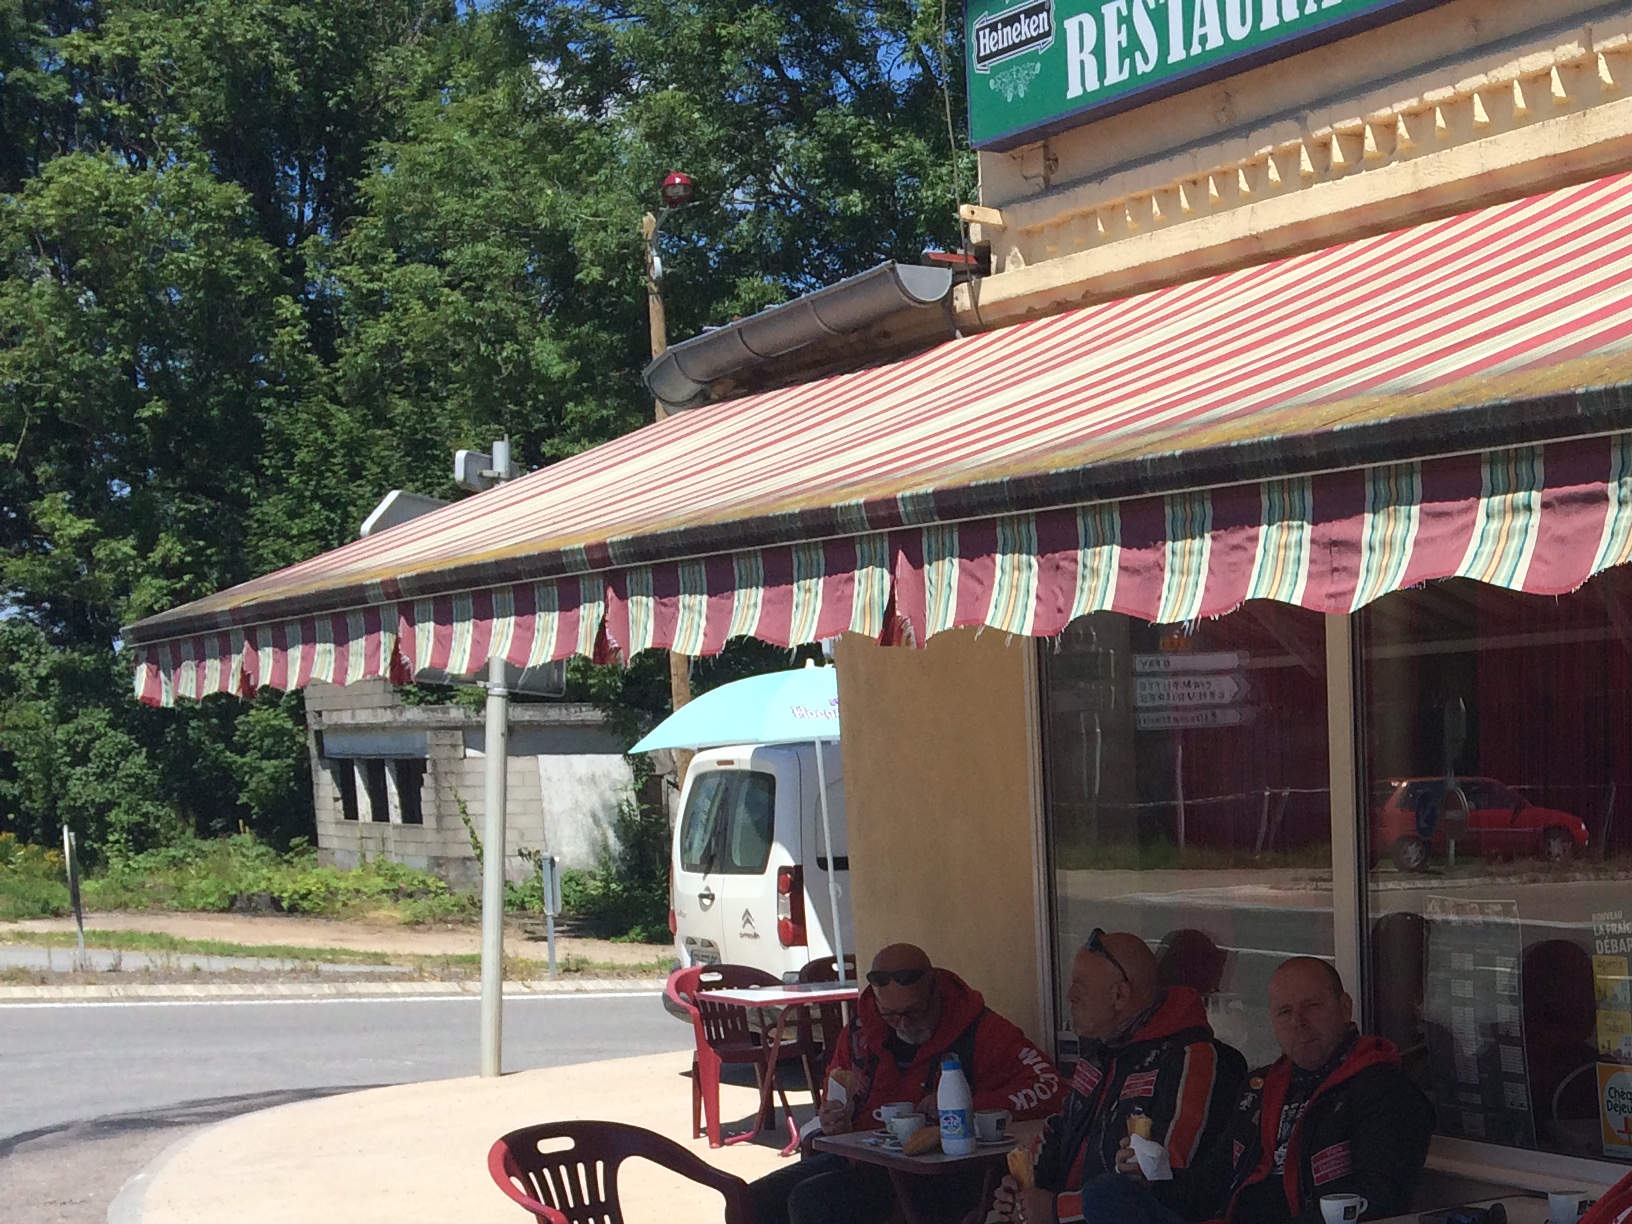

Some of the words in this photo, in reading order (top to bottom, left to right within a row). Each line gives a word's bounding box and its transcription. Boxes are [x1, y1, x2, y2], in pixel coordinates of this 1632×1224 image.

[978, 10, 1050, 58] Heineken
[1063, 0, 1343, 100] RESTAU
[1593, 924, 1606, 937] LA
